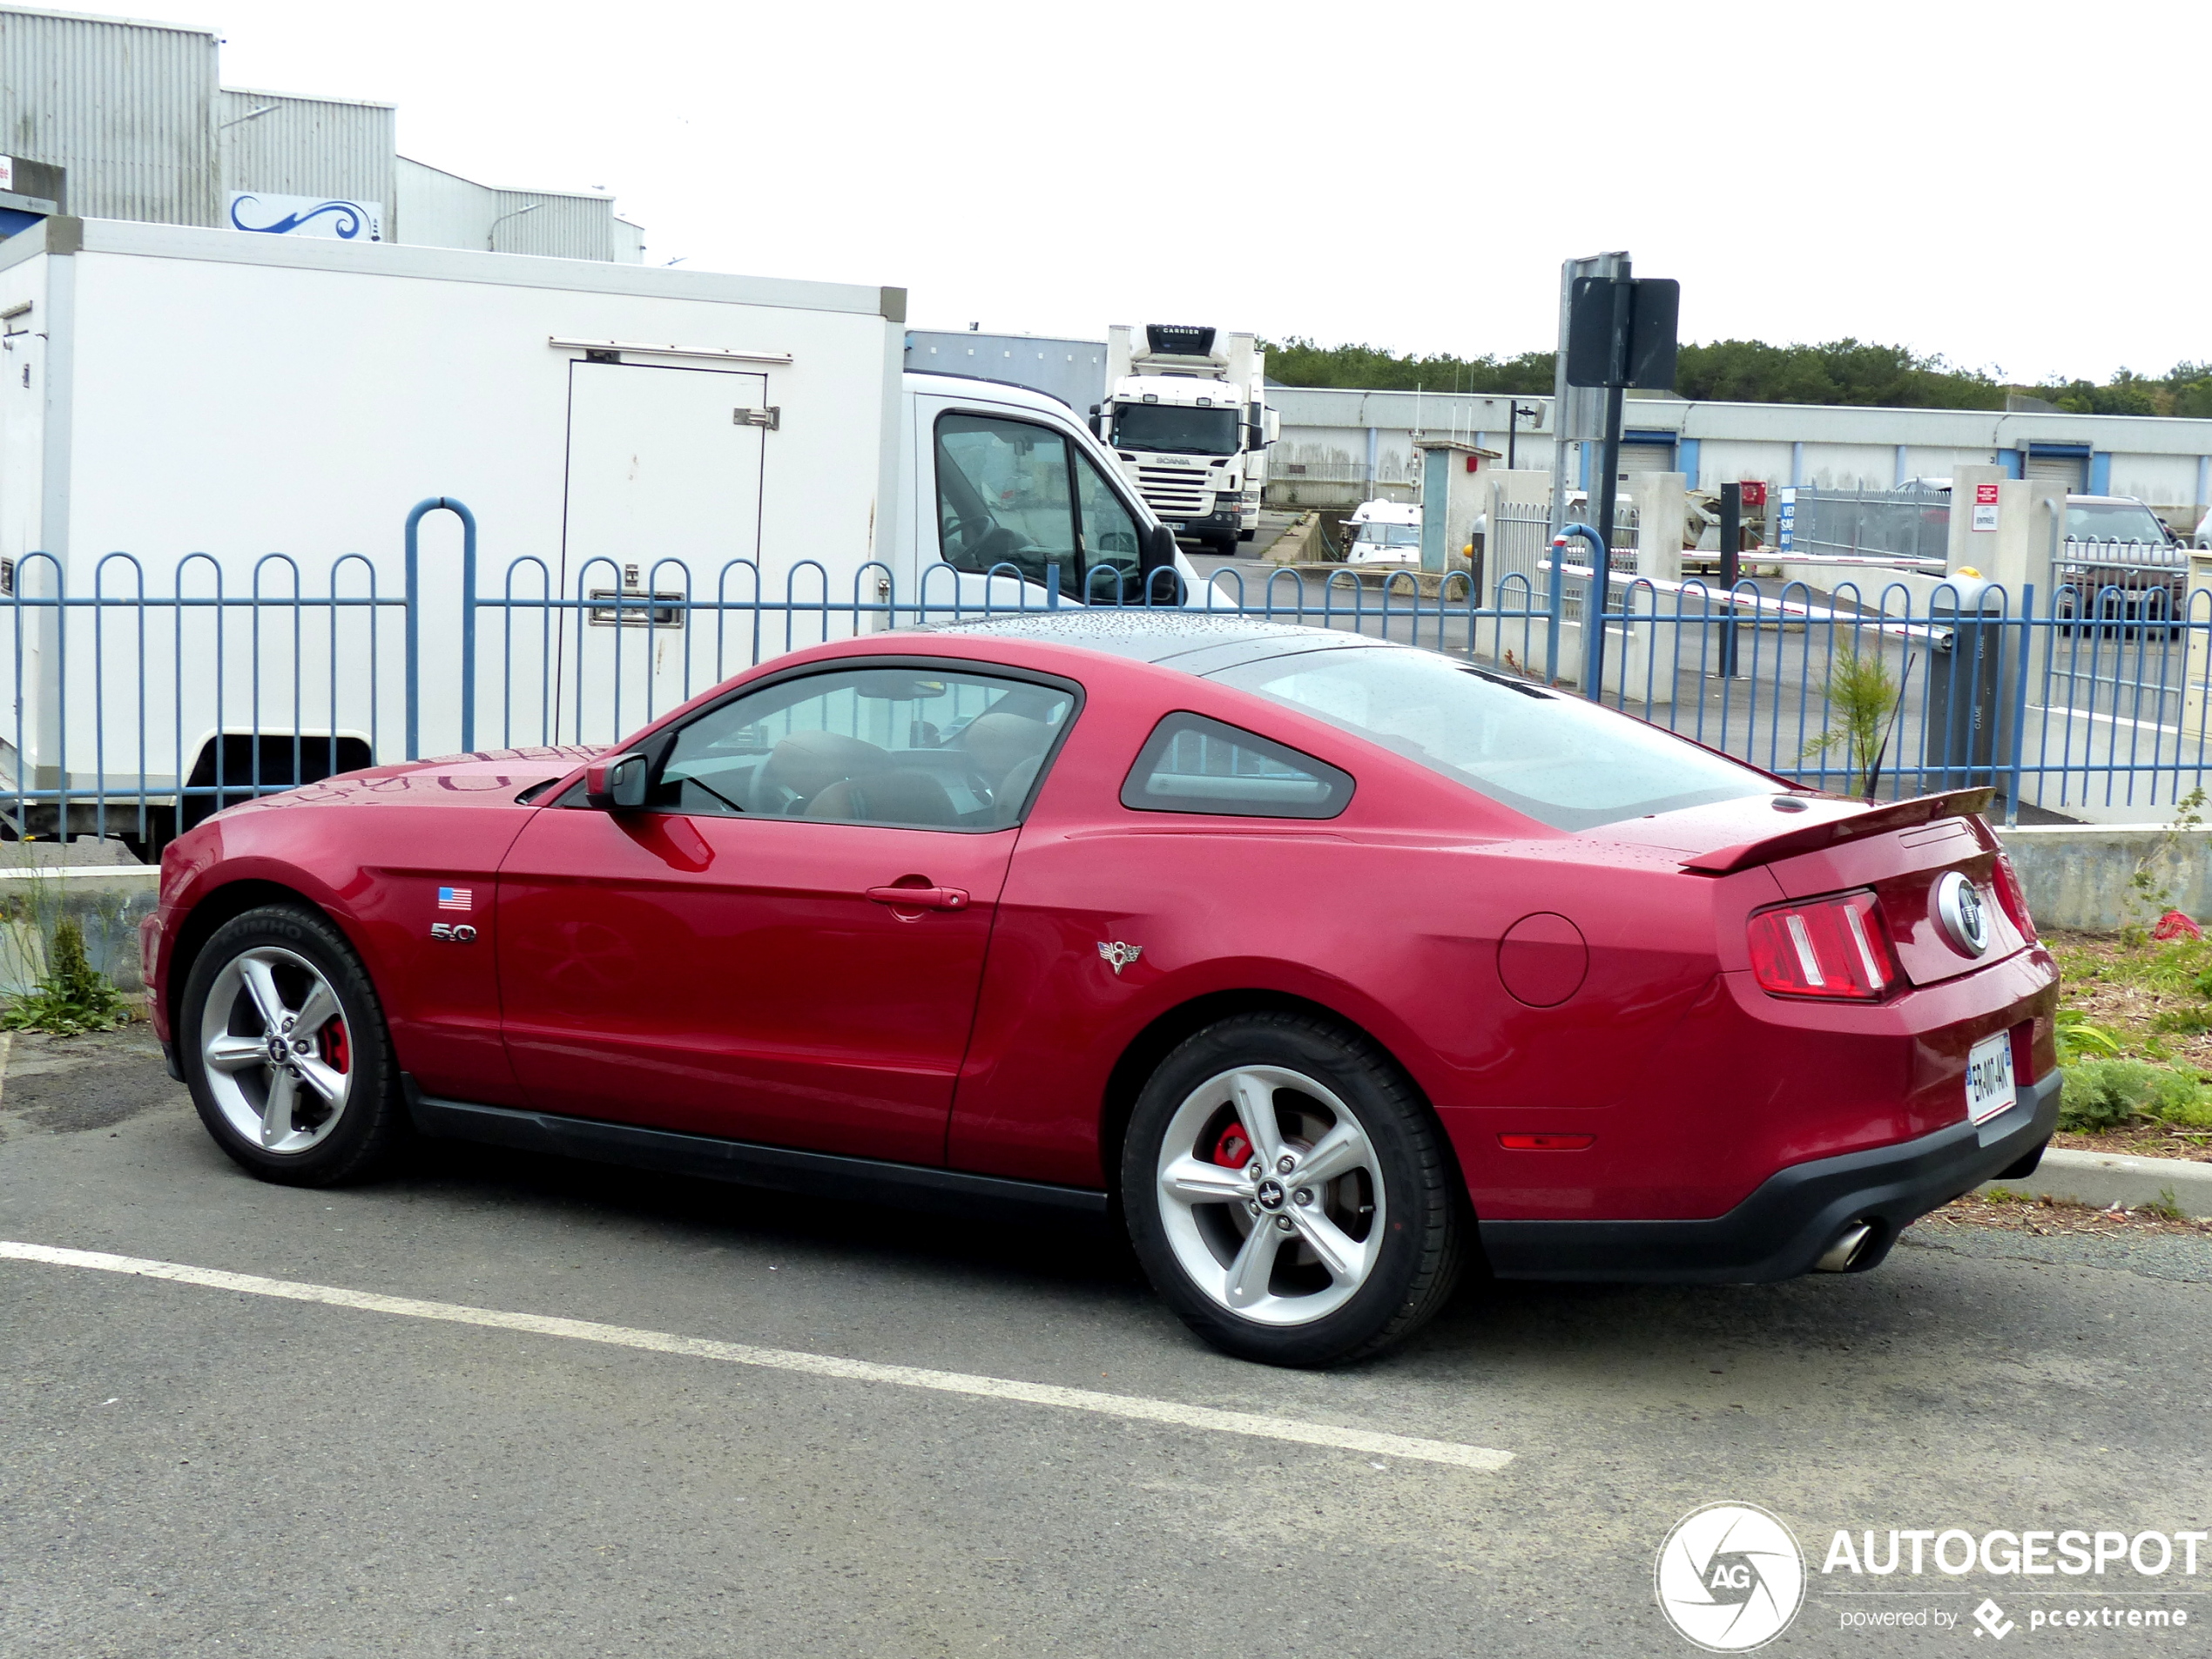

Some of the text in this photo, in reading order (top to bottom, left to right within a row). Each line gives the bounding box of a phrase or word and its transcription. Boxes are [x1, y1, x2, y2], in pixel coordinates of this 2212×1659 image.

[1574, 442, 1580, 451] 2
[1156, 456, 1190, 466] SCANIA
[1976, 516, 1995, 524] ENTRÉE
[430, 922, 477, 943] 5.0
